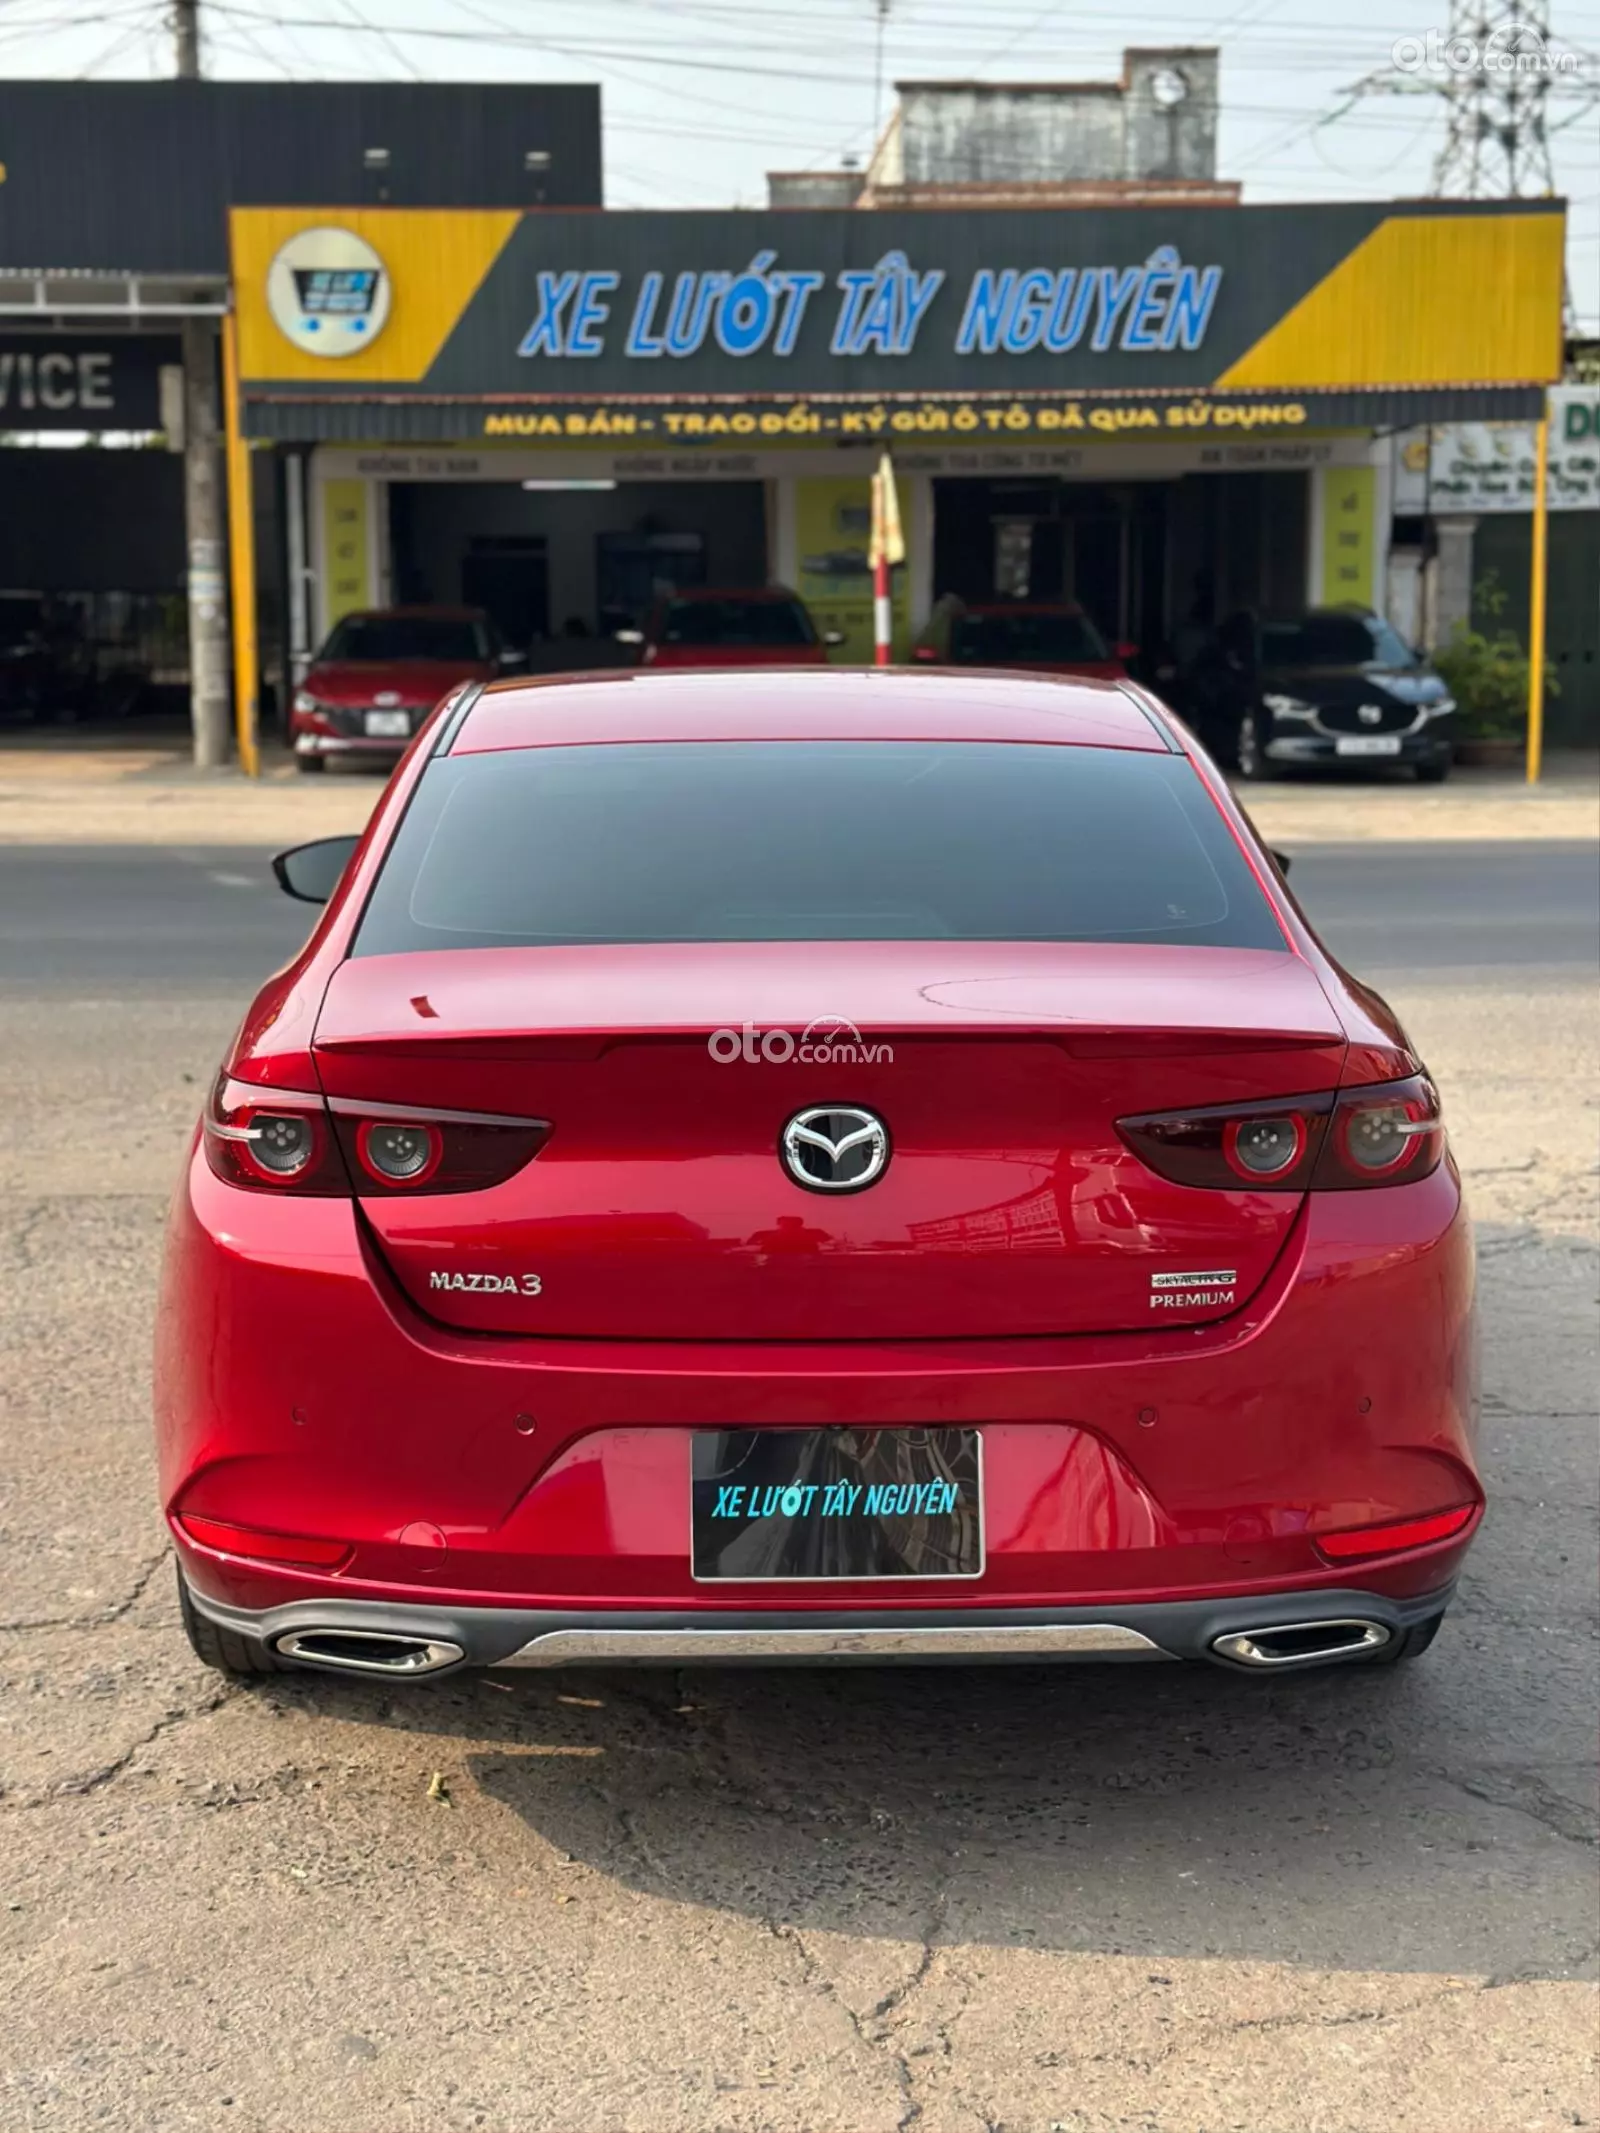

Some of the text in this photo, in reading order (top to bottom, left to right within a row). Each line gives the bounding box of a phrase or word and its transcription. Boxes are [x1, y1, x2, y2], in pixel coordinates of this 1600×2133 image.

[517, 244, 1223, 356] XE LƯỚT TÂY NGUYÊN
[485, 414, 561, 434] MUA
[565, 407, 636, 434] BÁN
[663, 414, 756, 433] TRAO
[841, 405, 885, 432] KÝ
[952, 404, 979, 431] Ô
[983, 404, 1030, 431] TÔ
[1089, 409, 1160, 432] QUA
[1166, 399, 1211, 427] SỬ
[1213, 403, 1306, 430] DỤNG
[1150, 1291, 1235, 1308] PREMIUM
[711, 1476, 959, 1517] XE LƯỚT TÂY NGUYÊN
